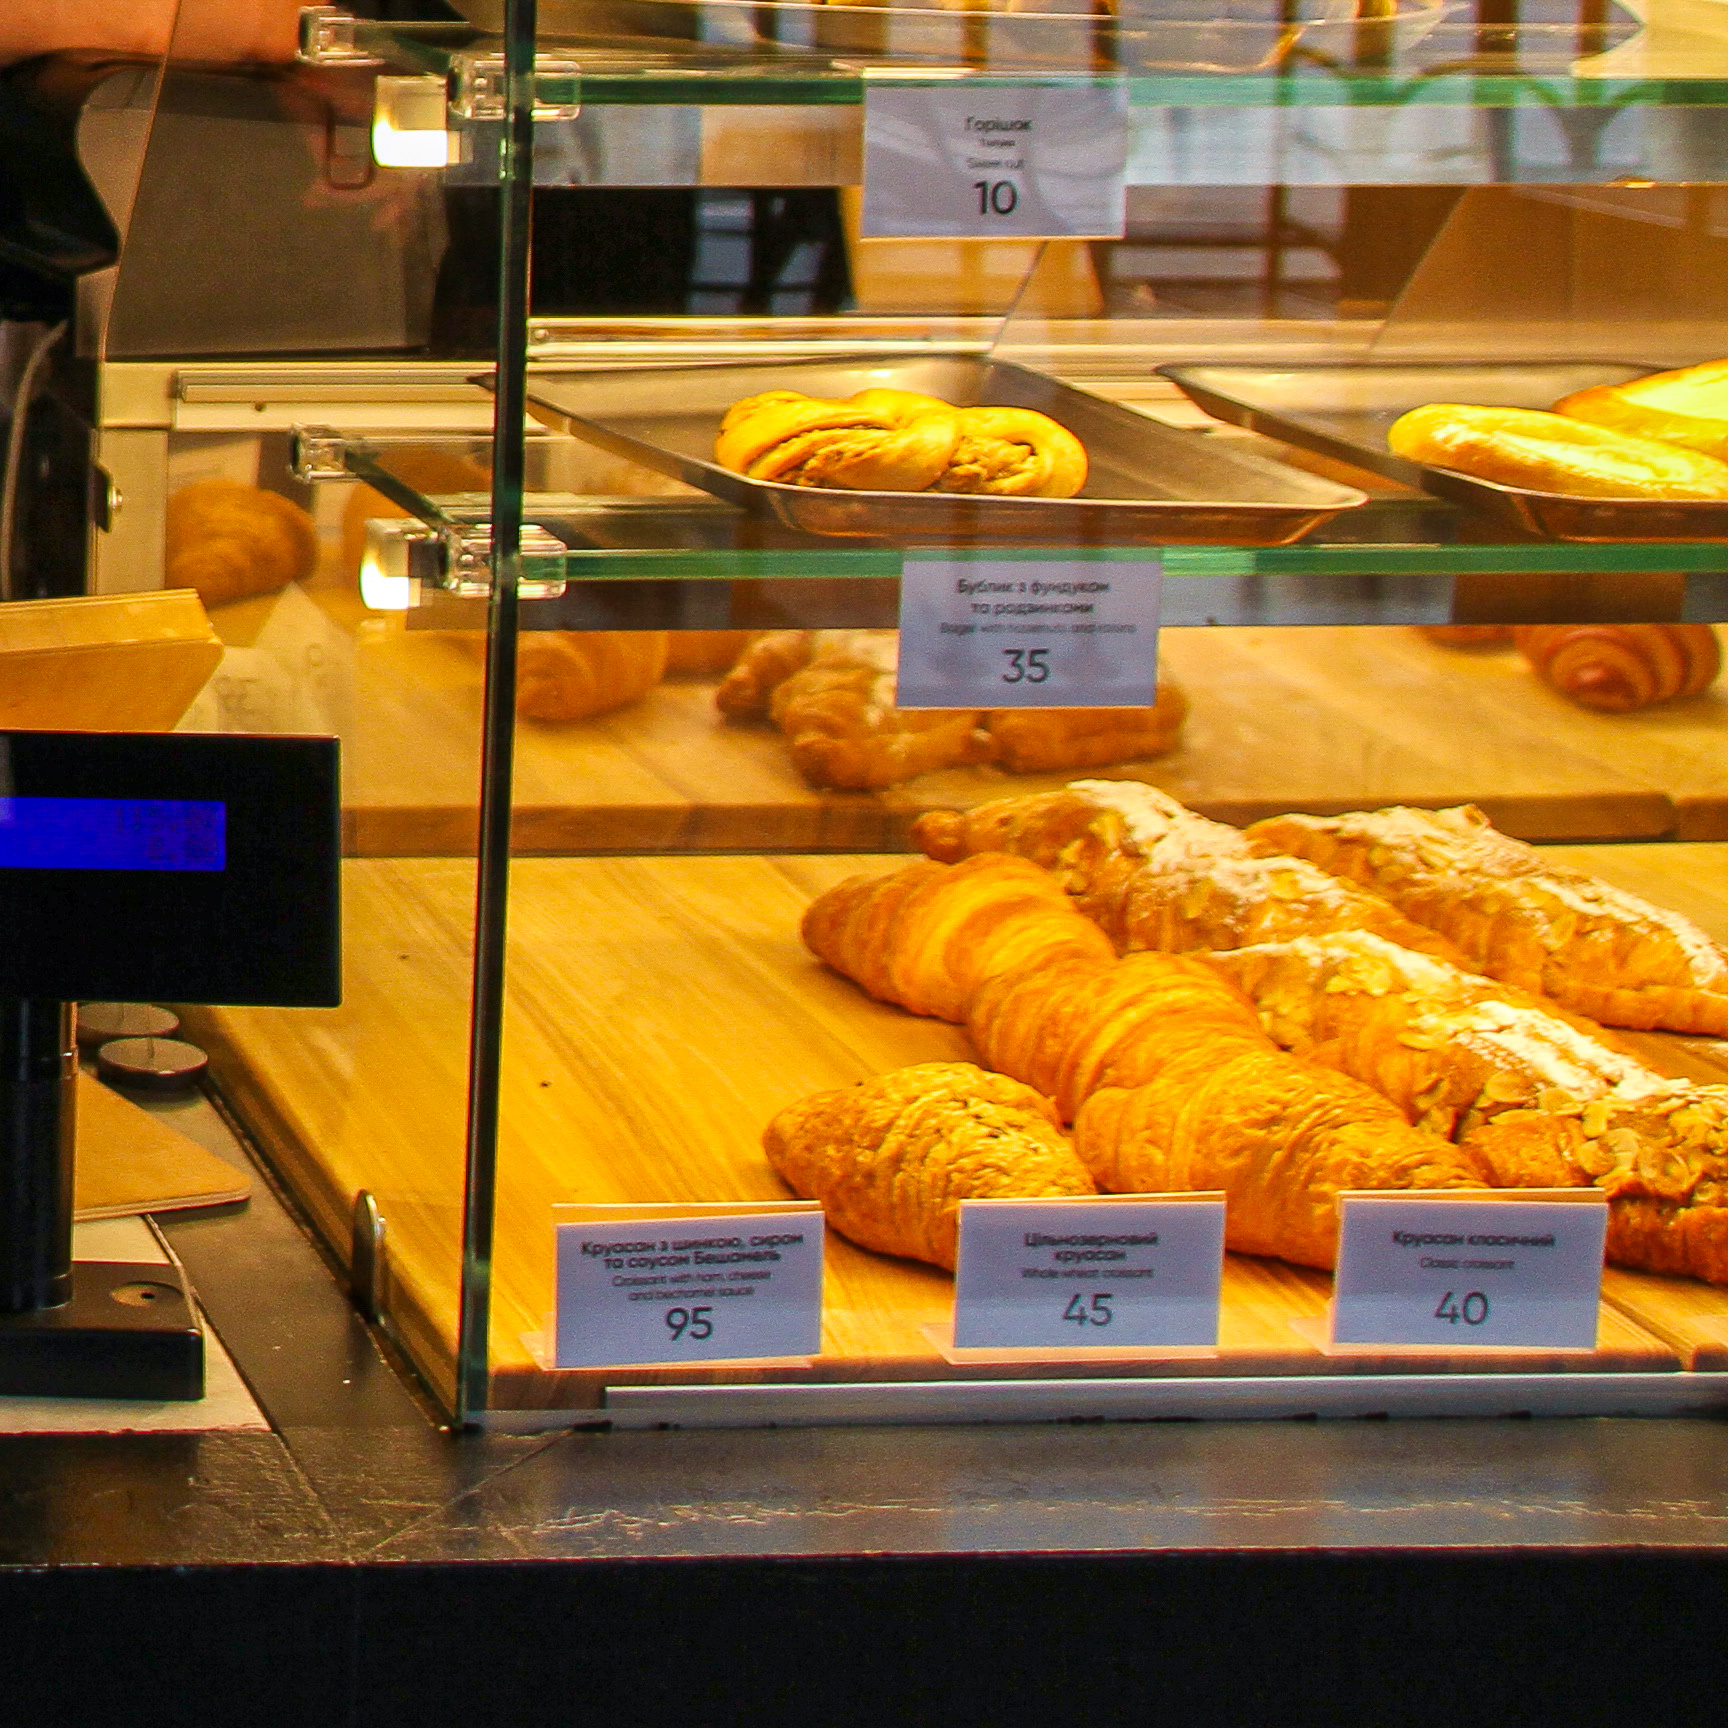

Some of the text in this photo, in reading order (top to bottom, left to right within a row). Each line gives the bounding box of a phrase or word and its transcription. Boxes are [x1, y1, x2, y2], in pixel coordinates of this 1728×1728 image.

[974, 181, 1018, 214] 10
[957, 579, 1014, 594] Бублик
[1002, 648, 1050, 683] 35
[581, 1241, 656, 1257] Круасан
[665, 1305, 714, 1341] 95
[1062, 1292, 1114, 1326] 45
[1434, 1290, 1489, 1325] 40
